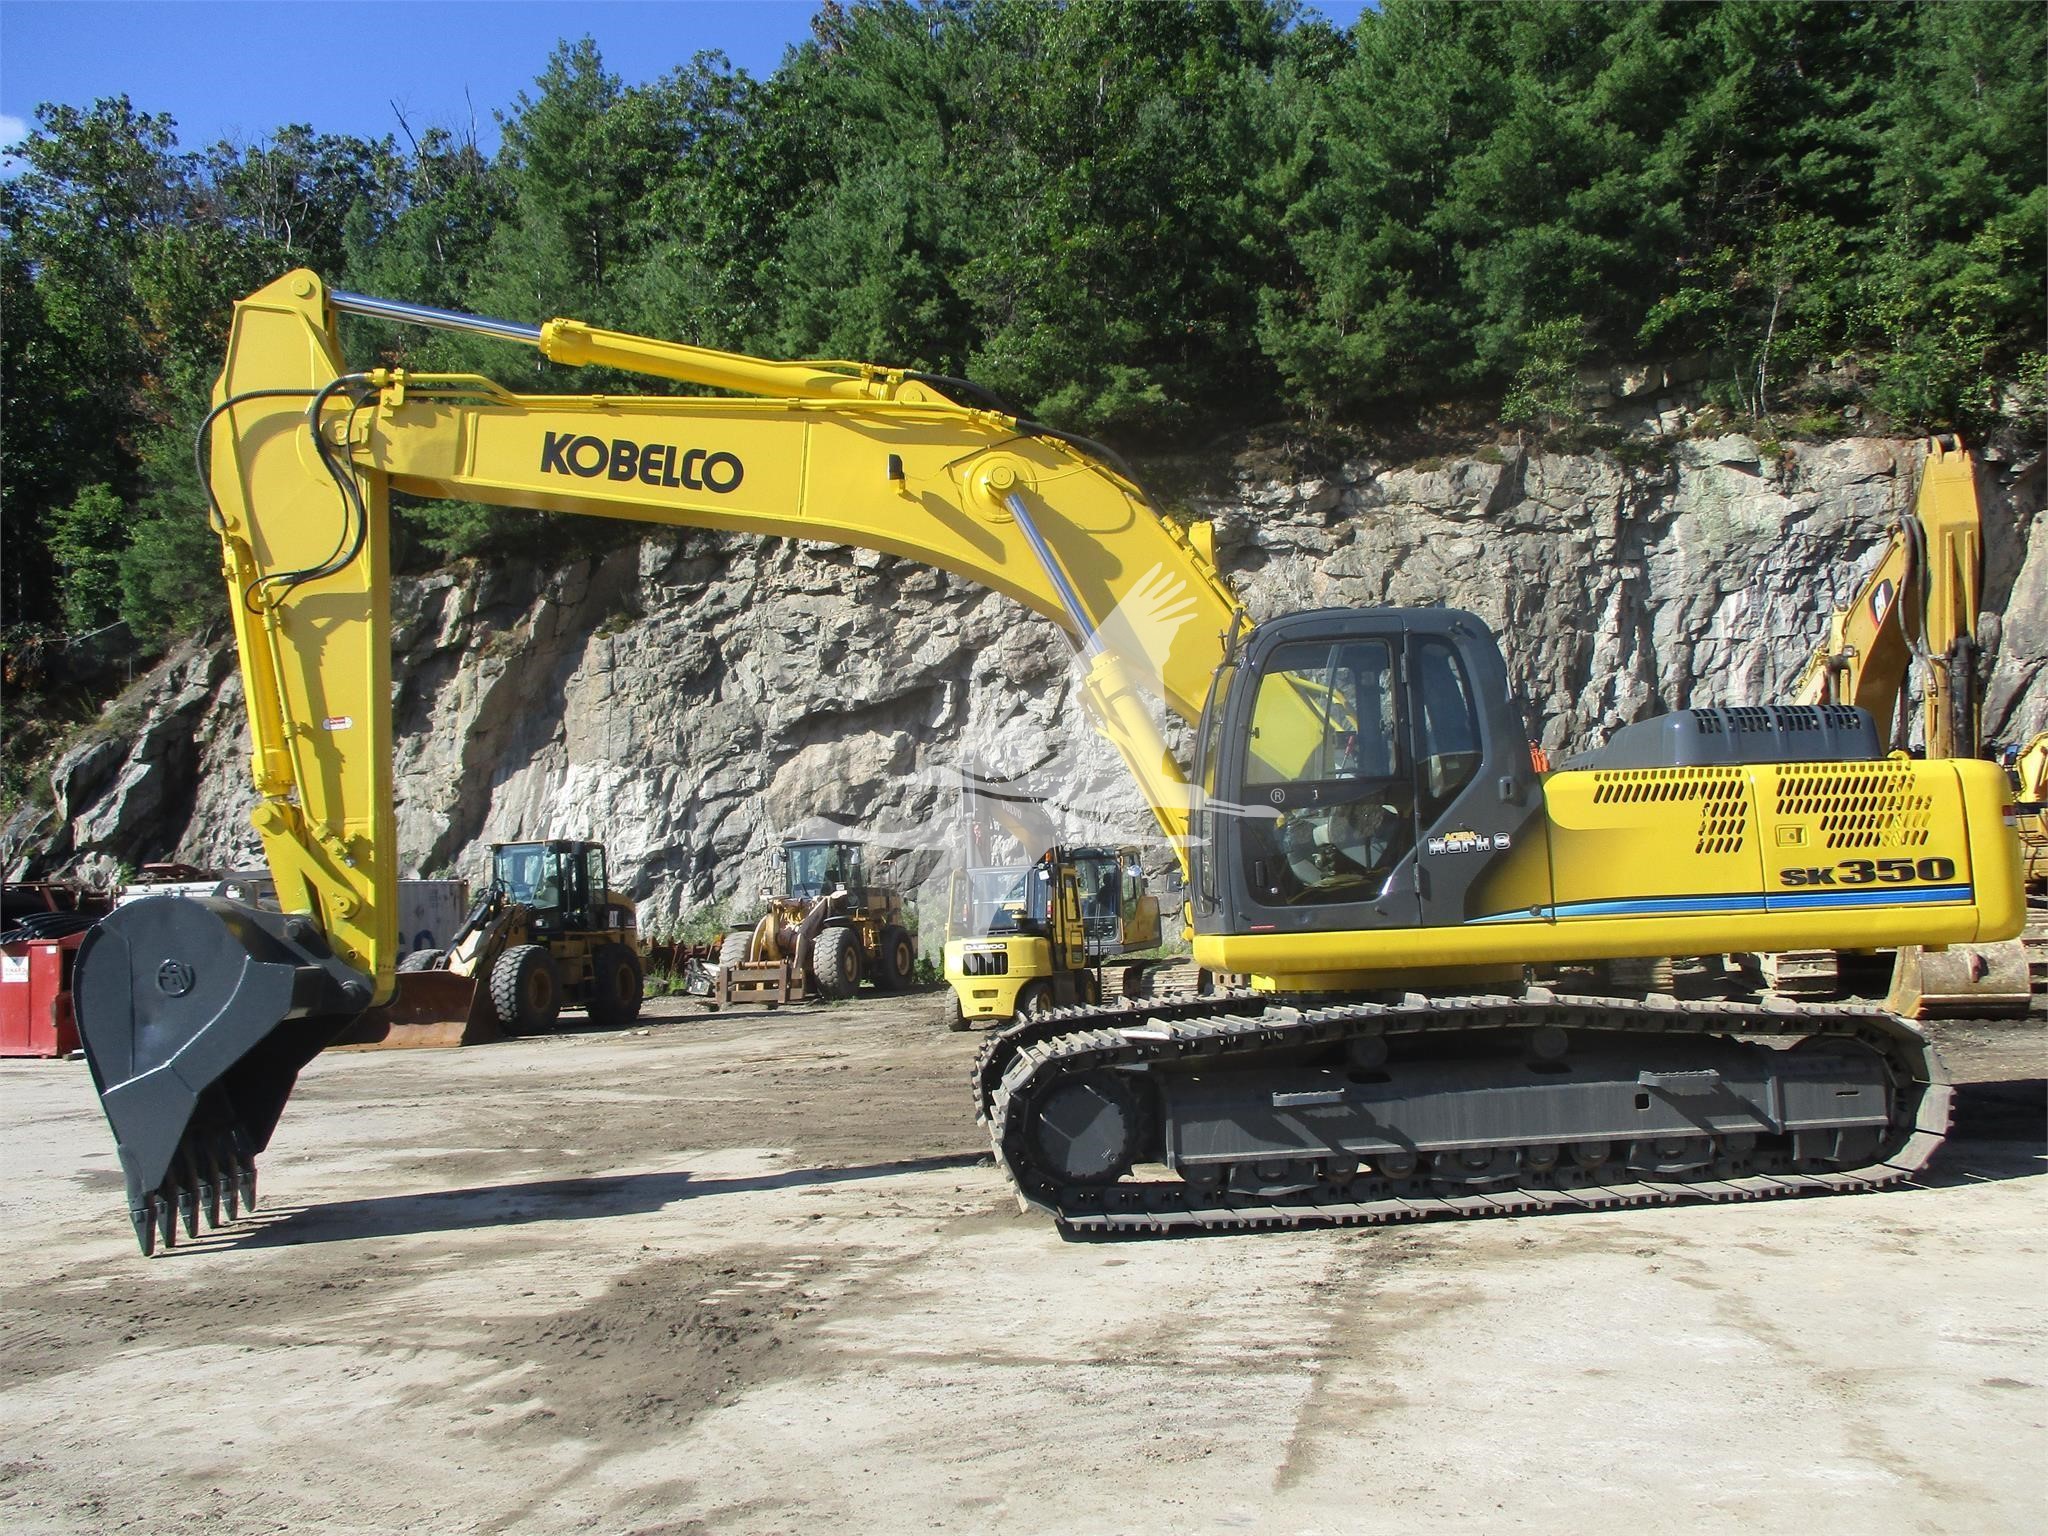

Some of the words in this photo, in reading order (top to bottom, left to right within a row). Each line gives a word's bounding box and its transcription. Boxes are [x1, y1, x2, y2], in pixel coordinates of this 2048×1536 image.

[540, 431, 744, 493] KOBELCO
[1428, 834, 1491, 855] Mark
[1493, 832, 1511, 850] 8
[1779, 857, 1955, 886] SK350
[965, 943, 1006, 951] DAEWOO
